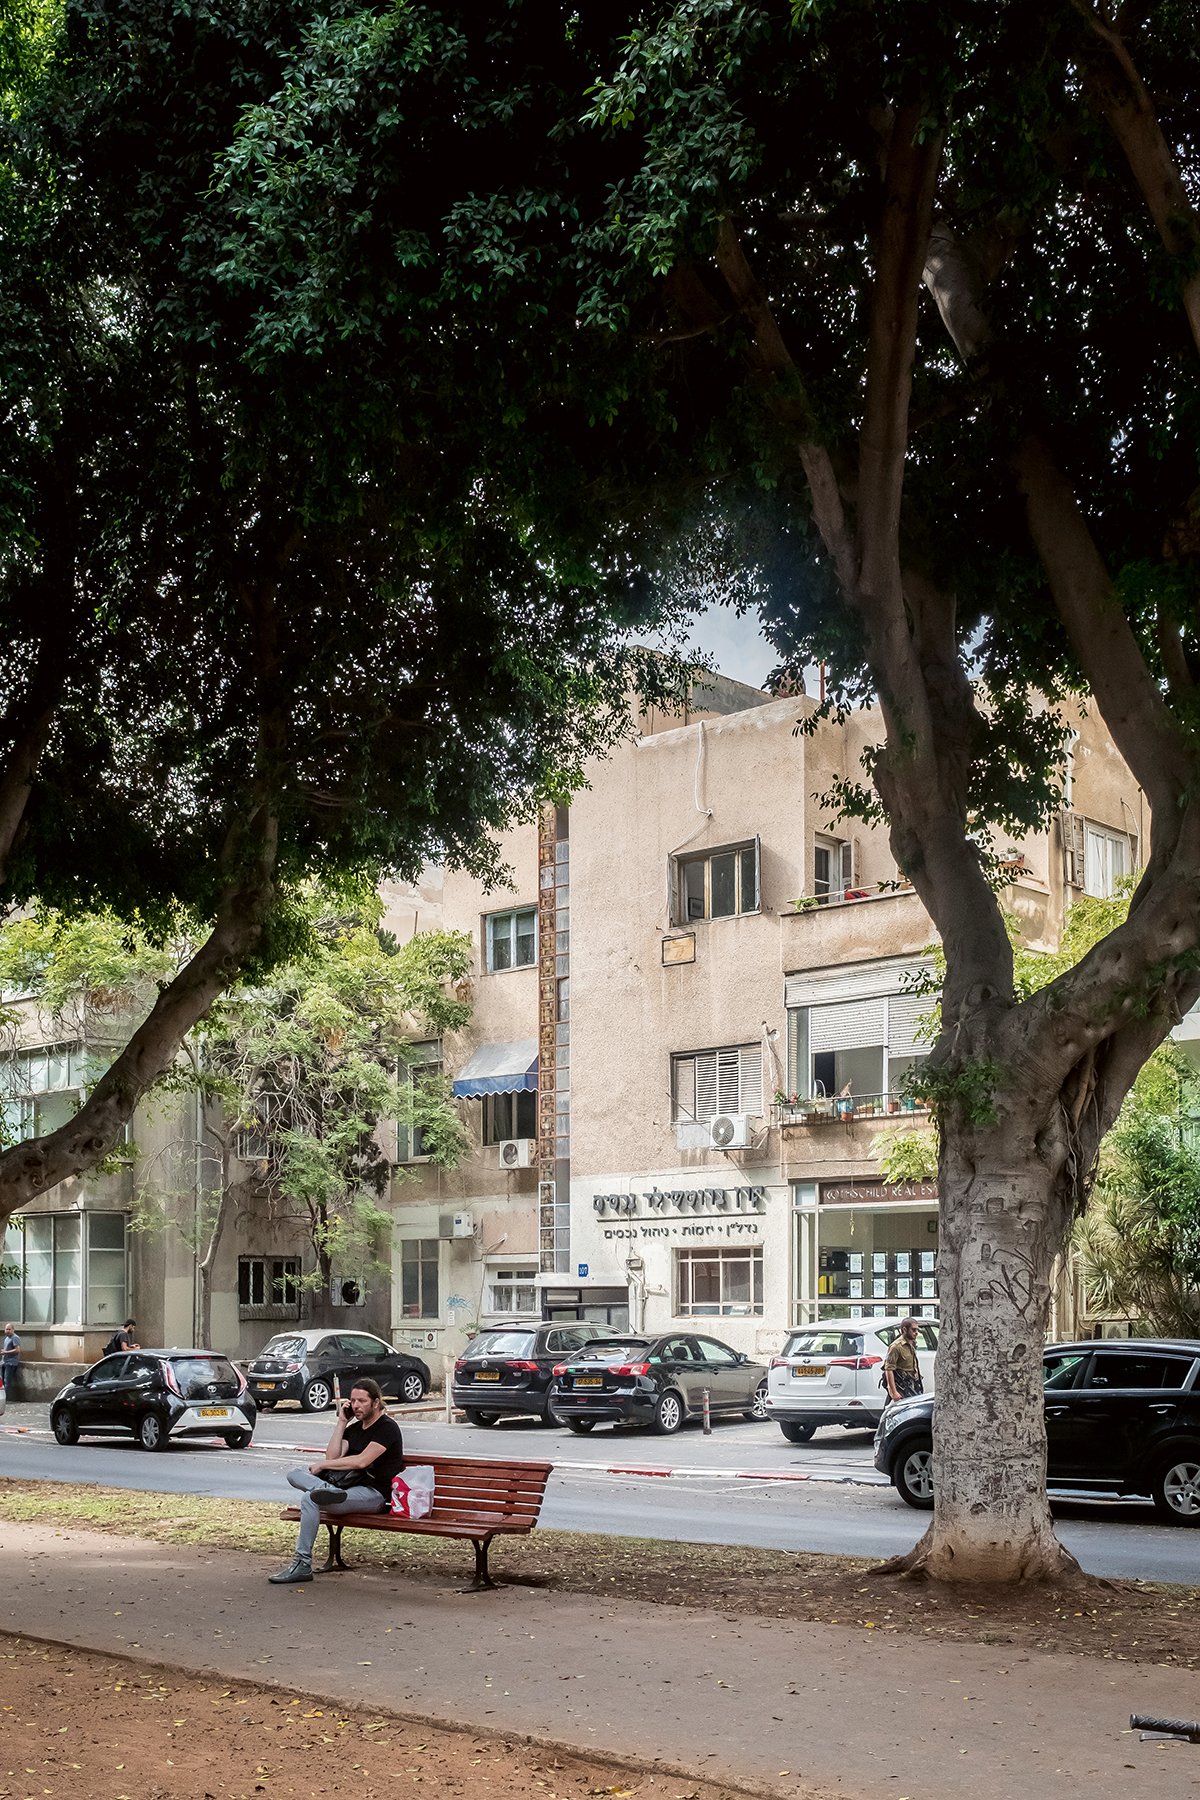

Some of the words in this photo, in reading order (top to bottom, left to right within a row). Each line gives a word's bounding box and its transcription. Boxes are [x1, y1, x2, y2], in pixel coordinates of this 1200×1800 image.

[734, 1185, 765, 1208] קרן
[891, 1185, 917, 1198] REAL
[592, 1192, 637, 1212] נכסים
[604, 1228, 638, 1240] נכסים
[640, 1226, 669, 1238] ניהול
[681, 1225, 714, 1236] יזמות
